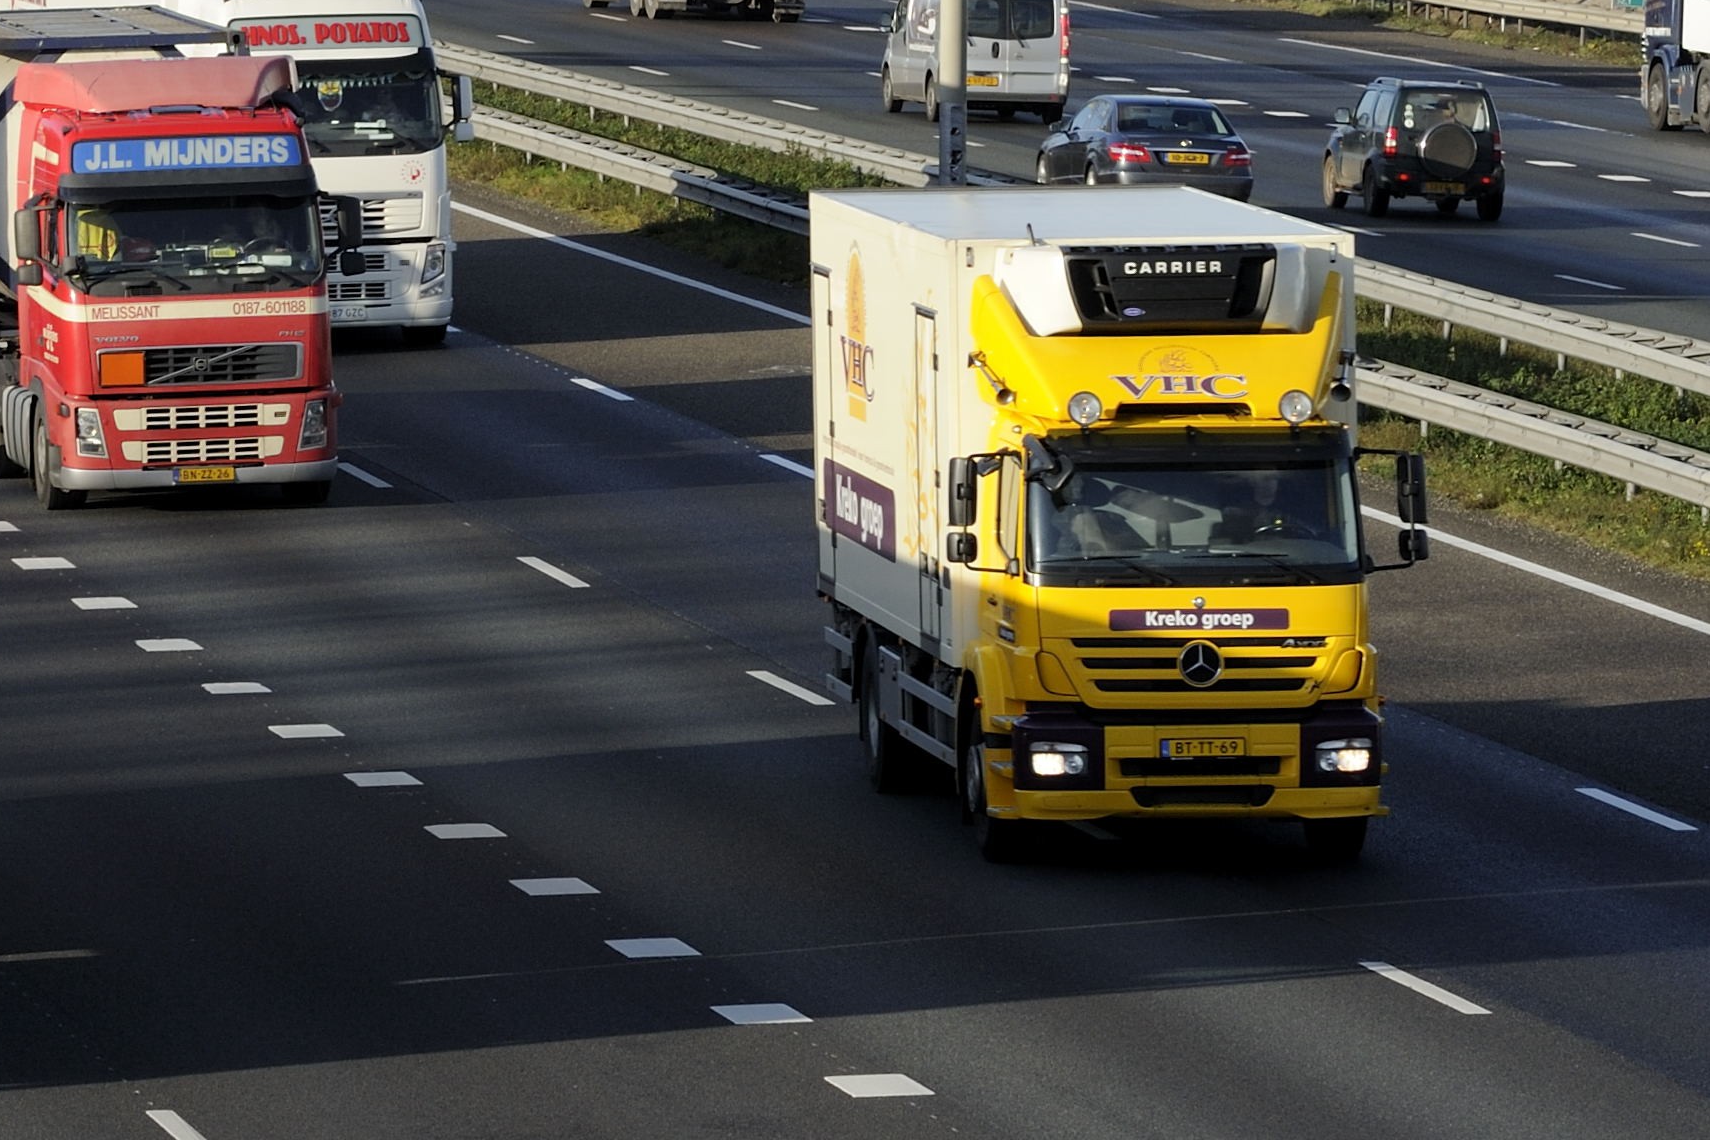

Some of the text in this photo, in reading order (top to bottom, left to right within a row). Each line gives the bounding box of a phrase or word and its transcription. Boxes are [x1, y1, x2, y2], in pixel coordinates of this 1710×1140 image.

[314, 21, 410, 45] POYATOS
[84, 136, 290, 171] J.L. MIJNDERS
[1123, 260, 1223, 275] CARRIER
[91, 299, 306, 320] MELISSANT 0187-601188
[93, 334, 139, 343] VOLVO
[840, 334, 875, 402] VHC
[1109, 373, 1249, 400] VHC
[835, 473, 884, 551] Kreko groep
[1145, 610, 1254, 629] Kreko groep
[1174, 740, 1238, 755] BT-TT-69
